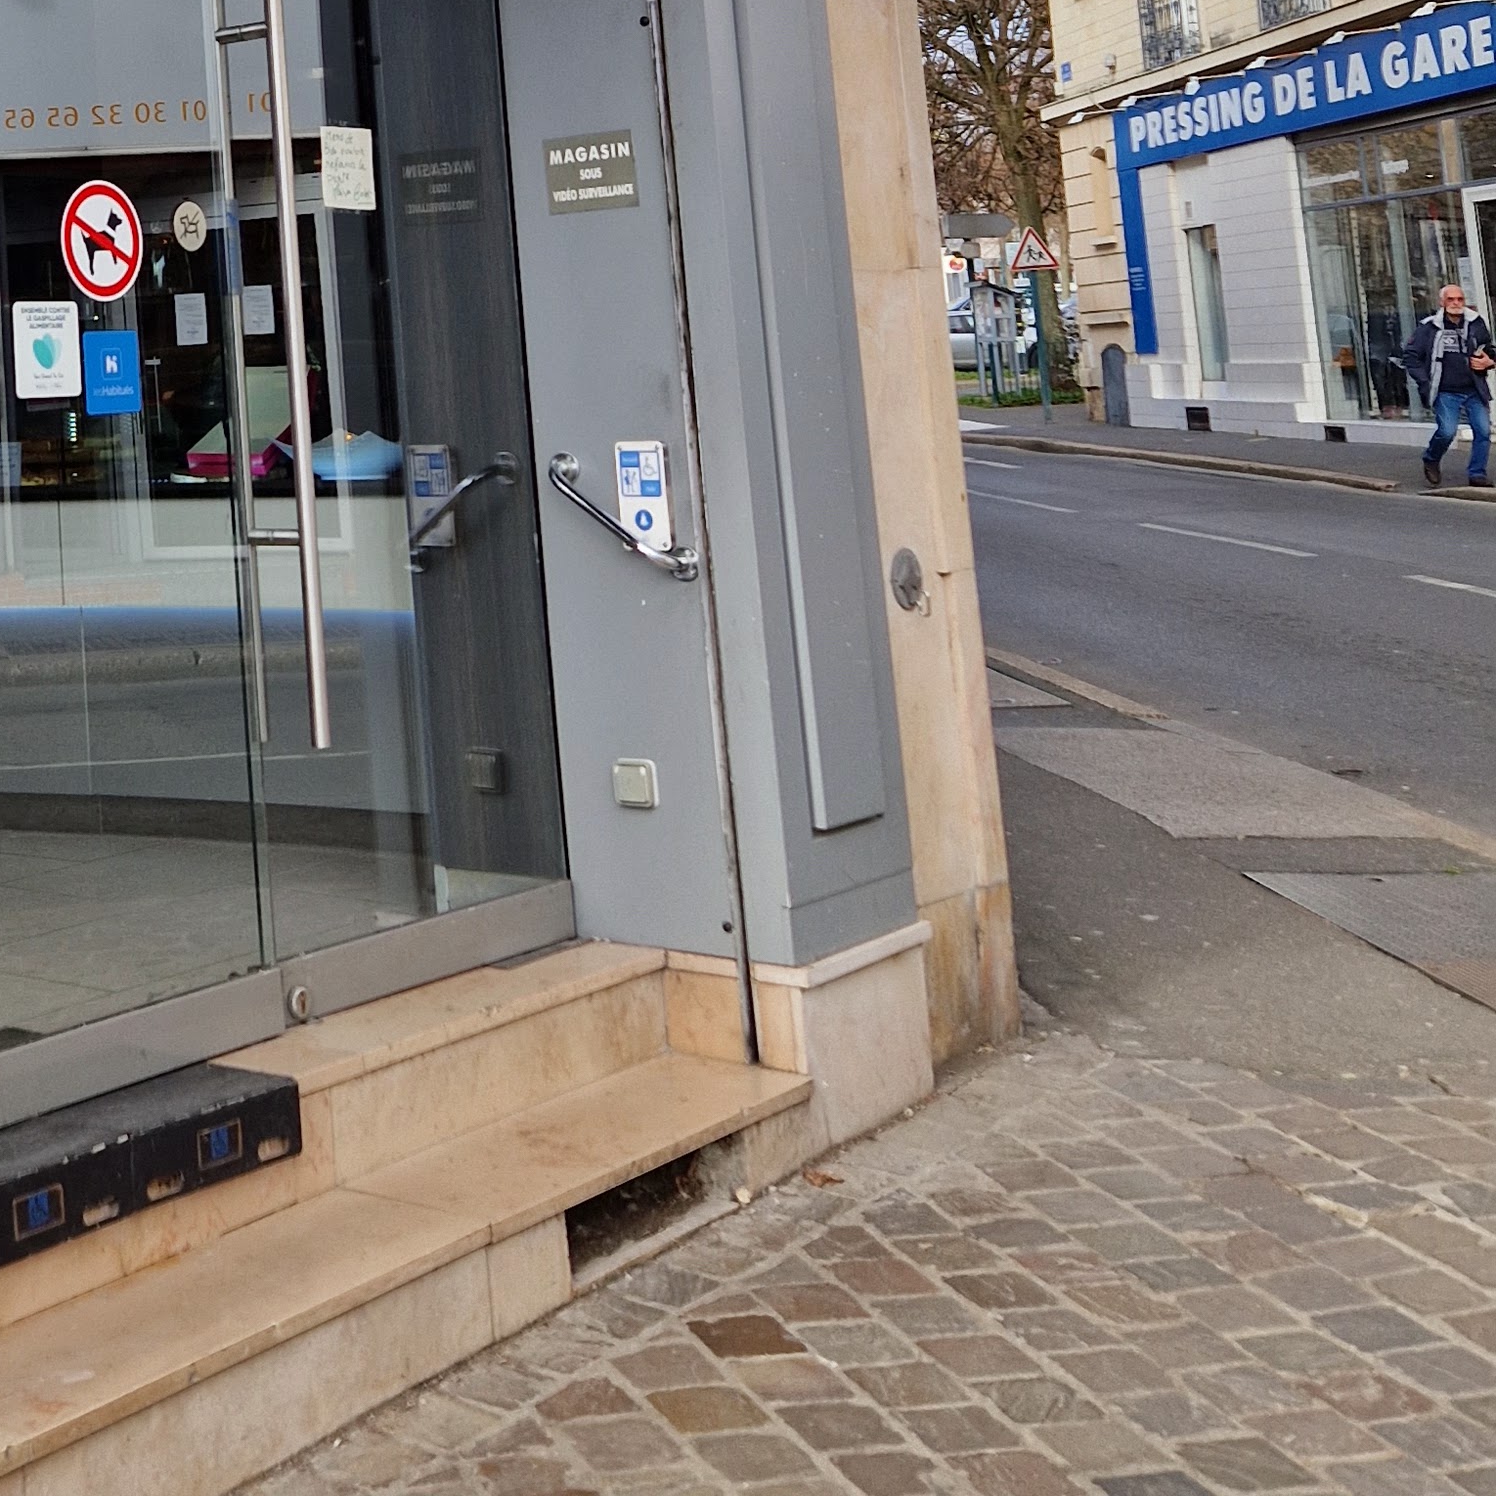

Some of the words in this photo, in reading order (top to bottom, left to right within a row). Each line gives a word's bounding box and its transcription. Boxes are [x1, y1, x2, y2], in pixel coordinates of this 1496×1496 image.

[1128, 82, 1266, 152] PRESSING
[1272, 66, 1317, 116] DE
[1323, 53, 1372, 103] LA
[1380, 15, 1496, 89] GARE
[549, 142, 631, 166] MAGASIN
[579, 167, 603, 180] SOUS
[552, 187, 578, 202] VIDÉO
[578, 184, 634, 200] SURVEILLANCE
